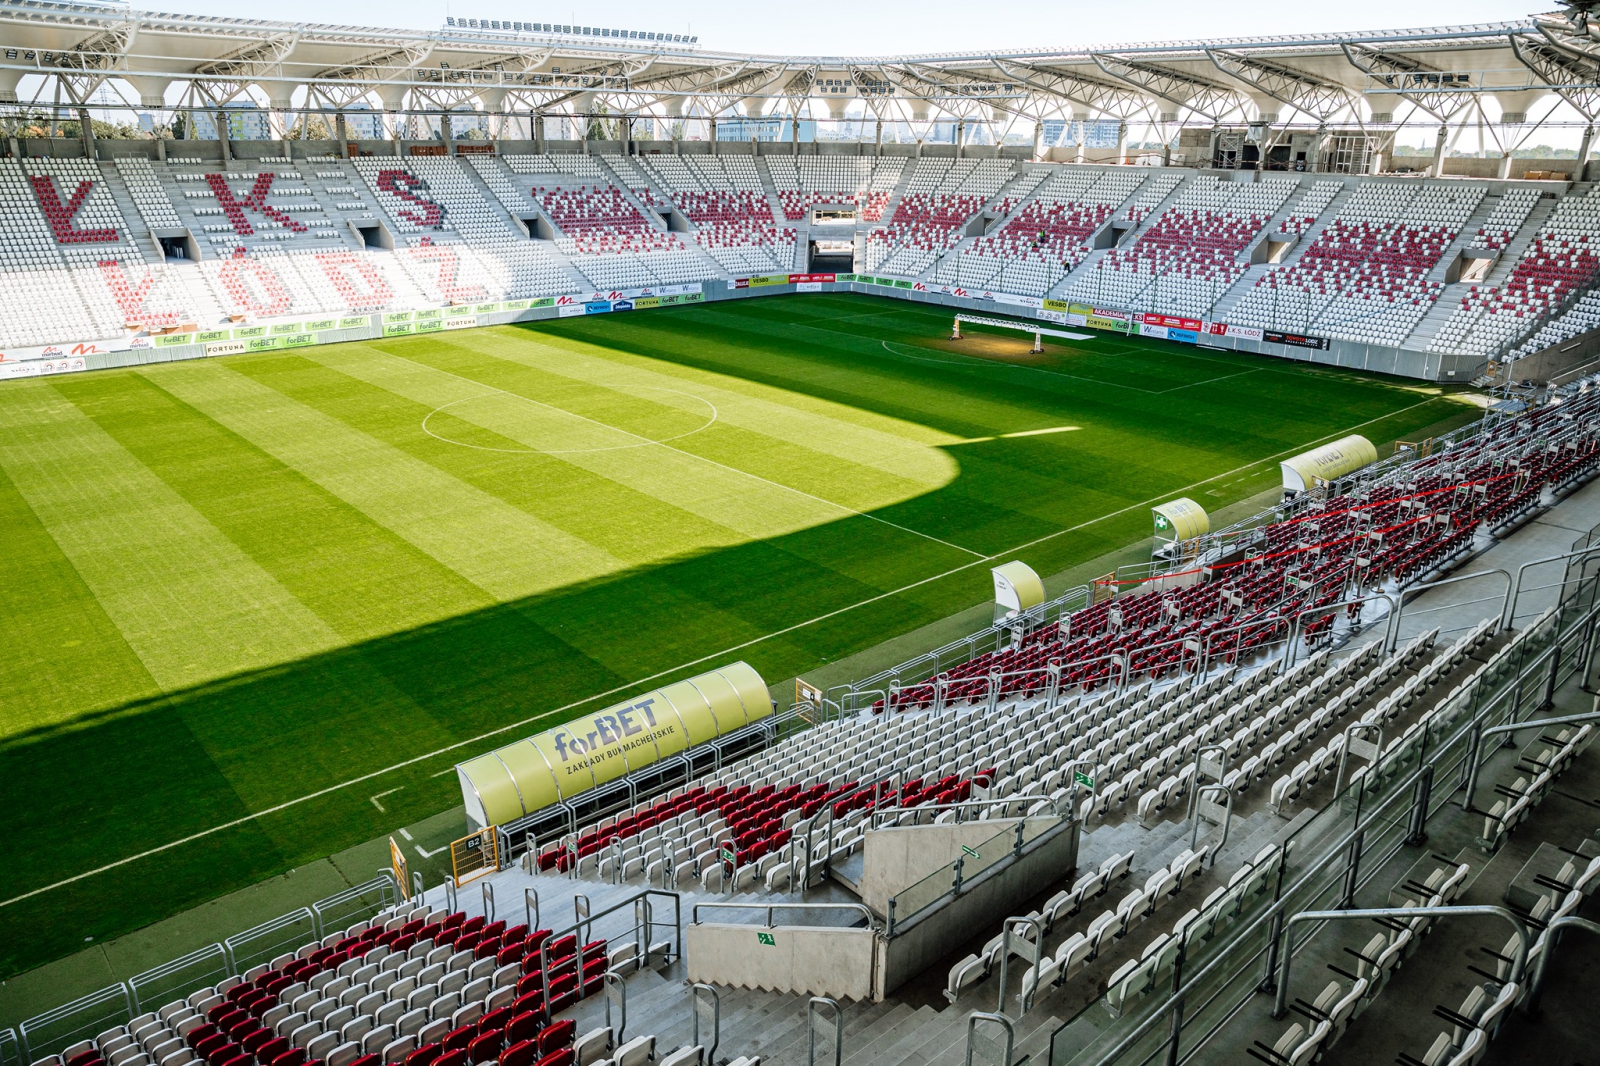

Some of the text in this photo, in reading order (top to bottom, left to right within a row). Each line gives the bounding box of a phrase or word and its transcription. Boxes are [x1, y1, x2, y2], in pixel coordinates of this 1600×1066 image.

[1047, 300, 1068, 309] VESBO
[389, 312, 409, 321] forBET
[418, 309, 437, 318] forBET
[1093, 308, 1125, 319] AKADEMIA
[311, 320, 333, 329] forBET
[342, 317, 363, 326] forBET
[419, 320, 443, 331] forBET
[446, 318, 476, 328] FORTUNA
[1086, 319, 1112, 328] FORTUNA
[240, 327, 263, 336] forBET
[274, 324, 296, 333] forBET
[387, 323, 412, 334] forBET
[163, 335, 188, 344] forBET
[199, 331, 223, 340] forBET
[286, 334, 313, 345] forBET
[249, 337, 277, 349] forBET
[207, 343, 245, 353] FORTUNA
[554, 697, 658, 763] forBET
[565, 752, 606, 775] ZAKŁADY
[468, 838, 480, 848] B2
